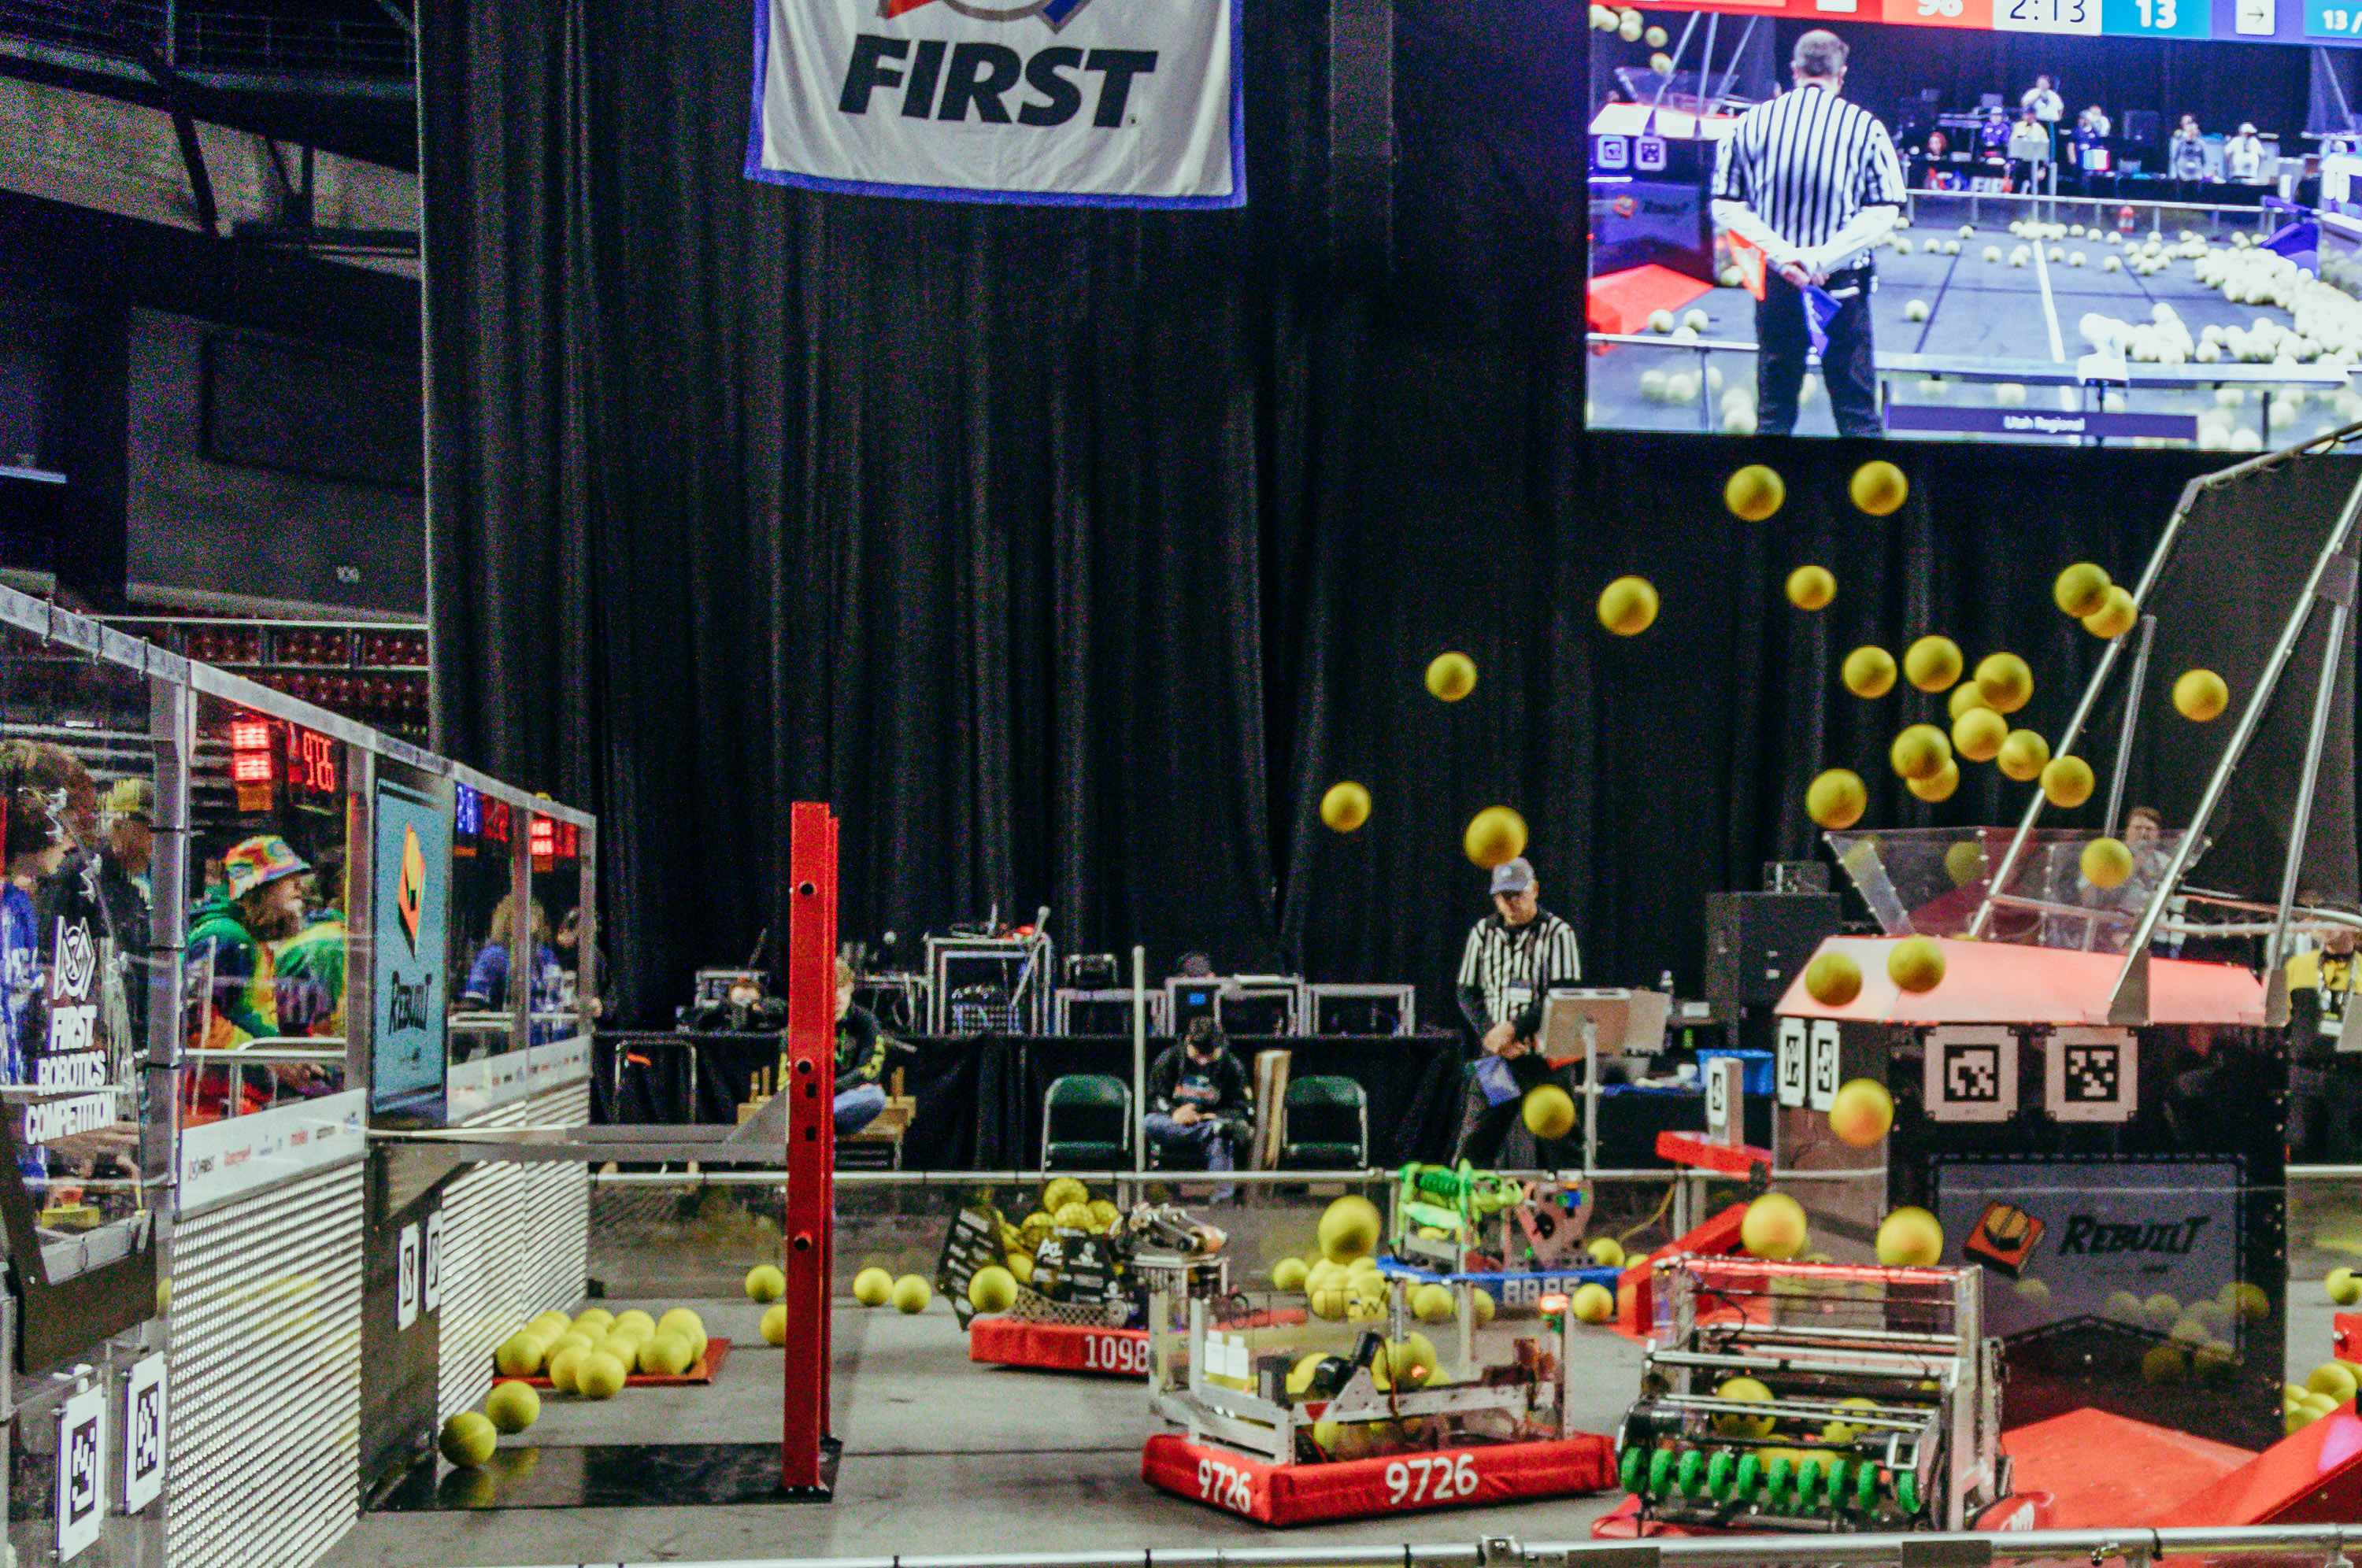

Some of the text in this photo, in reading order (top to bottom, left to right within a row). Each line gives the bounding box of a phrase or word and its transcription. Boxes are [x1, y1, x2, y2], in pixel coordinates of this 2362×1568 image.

[2010, 0, 2086, 23] 2:13
[2135, 0, 2177, 29] 13
[839, 34, 1159, 128] FIRST
[2002, 416, 2085, 433] Utah Regional
[50, 1005, 97, 1051] FIRST
[38, 1050, 106, 1096] ROBOTICS
[24, 1091, 116, 1145] COMPETITION
[2058, 1215, 2210, 1256] REBUILT
[1085, 1335, 1150, 1373] 1098
[1198, 1459, 1251, 1513] 9726
[1385, 1453, 1479, 1504] 9726
